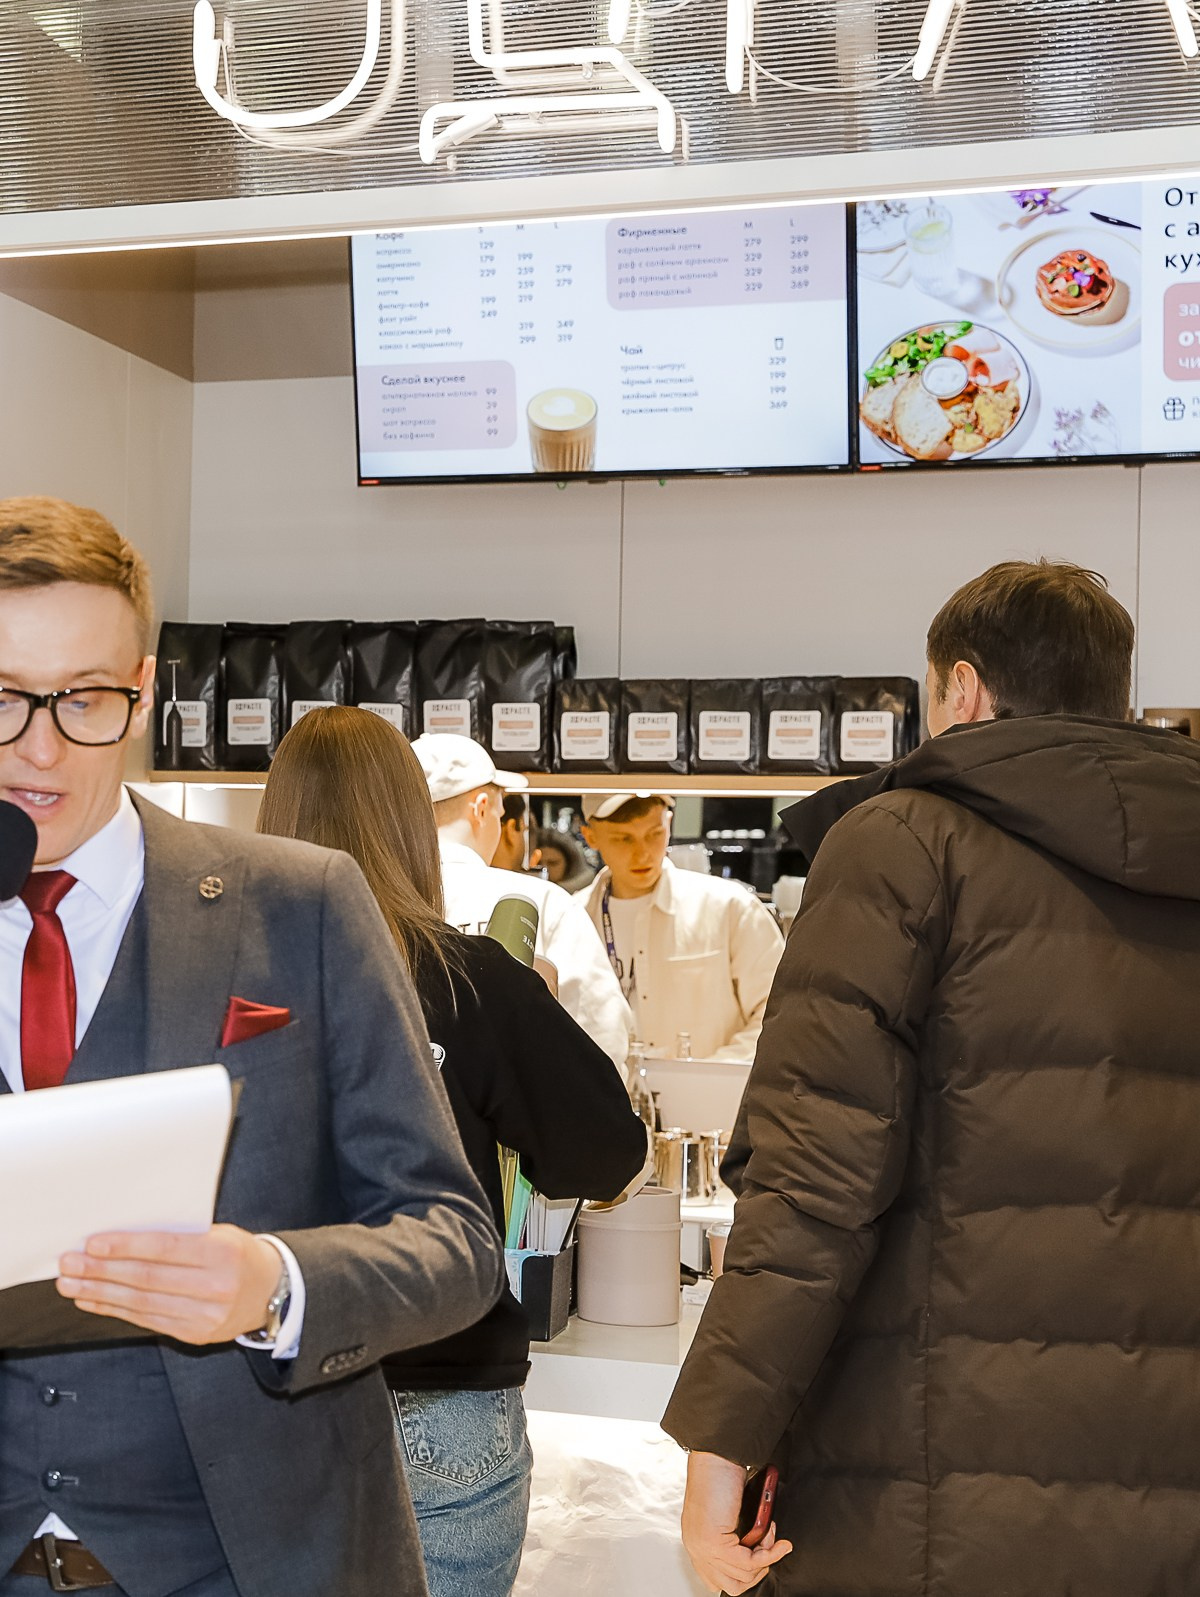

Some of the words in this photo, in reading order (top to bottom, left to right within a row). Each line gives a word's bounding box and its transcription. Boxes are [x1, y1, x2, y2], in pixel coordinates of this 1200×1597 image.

[1164, 187, 1198, 207] От
[617, 226, 687, 239] Фирменные
[1187, 221, 1200, 237] а
[619, 344, 643, 356] Чай
[381, 374, 420, 386] Сделай
[423, 373, 465, 385] вкуснее
